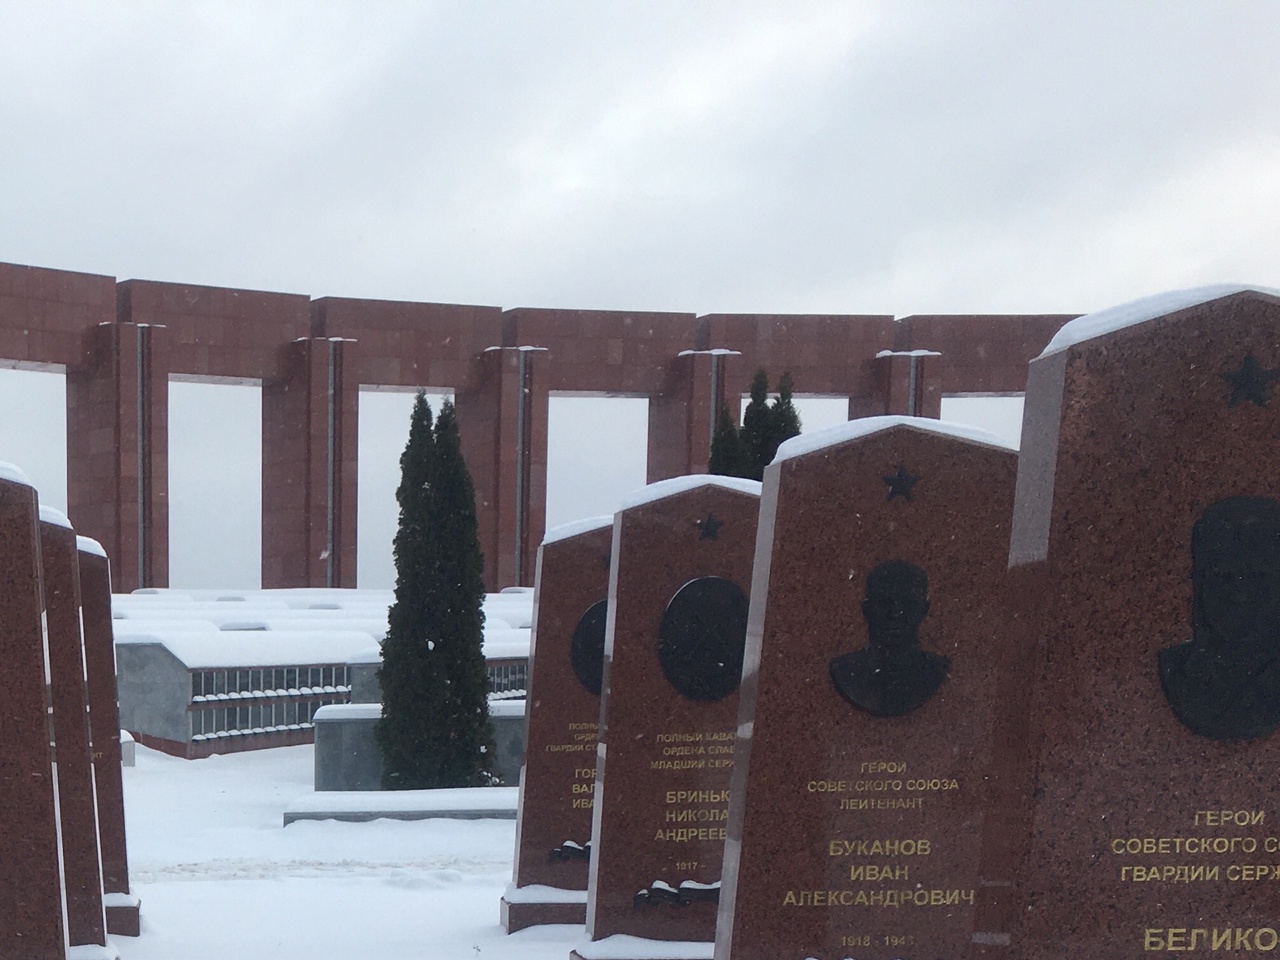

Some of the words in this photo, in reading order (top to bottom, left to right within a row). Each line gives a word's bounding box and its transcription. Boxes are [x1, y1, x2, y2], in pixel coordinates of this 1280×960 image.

[706, 732, 738, 741] КАВА
[906, 779, 959, 791] СОЮЗА
[829, 839, 931, 856] БУКАНОВ
[1111, 837, 1257, 854] СОВЕТСКОГО
[1264, 836, 1280, 853] С
[676, 861, 698, 870] 1917
[850, 865, 909, 880] ИВАН
[1121, 865, 1219, 883] ГВАРДИИ
[782, 889, 975, 908] АЛЕКСАНДРОВИЧ
